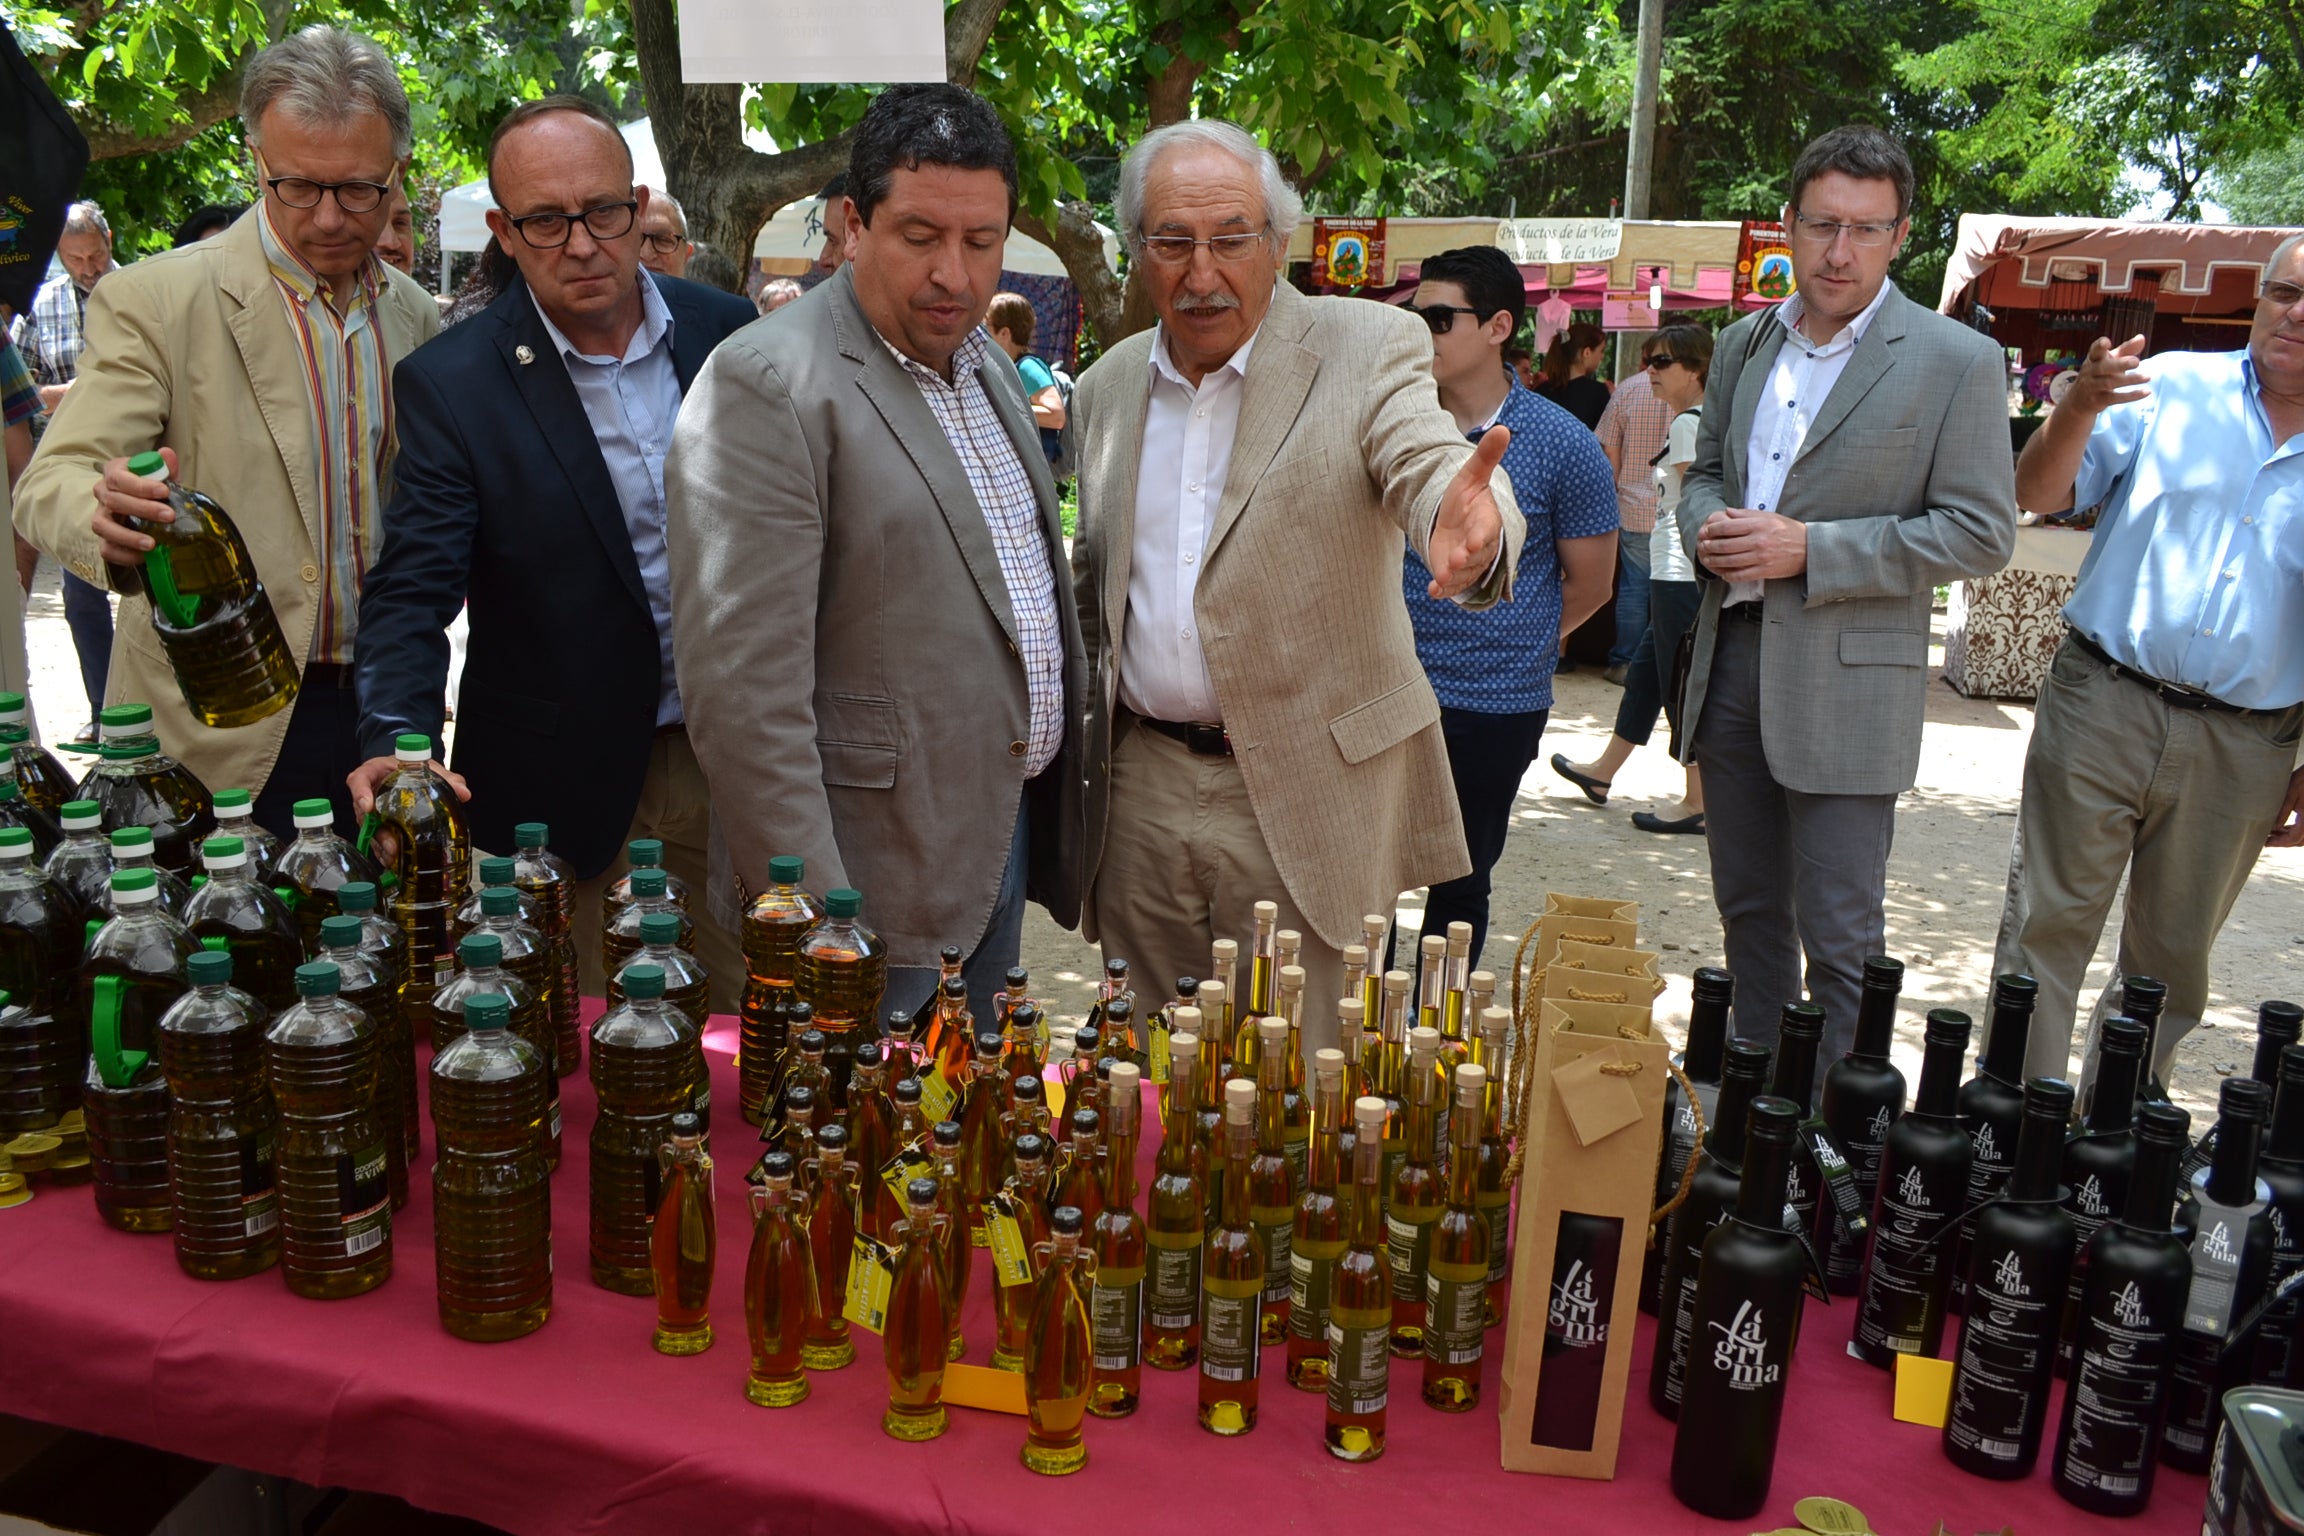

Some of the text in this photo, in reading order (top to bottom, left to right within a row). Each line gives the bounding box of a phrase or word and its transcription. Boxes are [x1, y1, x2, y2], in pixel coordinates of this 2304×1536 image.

[1498, 224, 1619, 240] Productos de la Vera
[0, 252, 31, 265] livico
[1574, 245, 1586, 260] la
[1588, 246, 1616, 260] Vera
